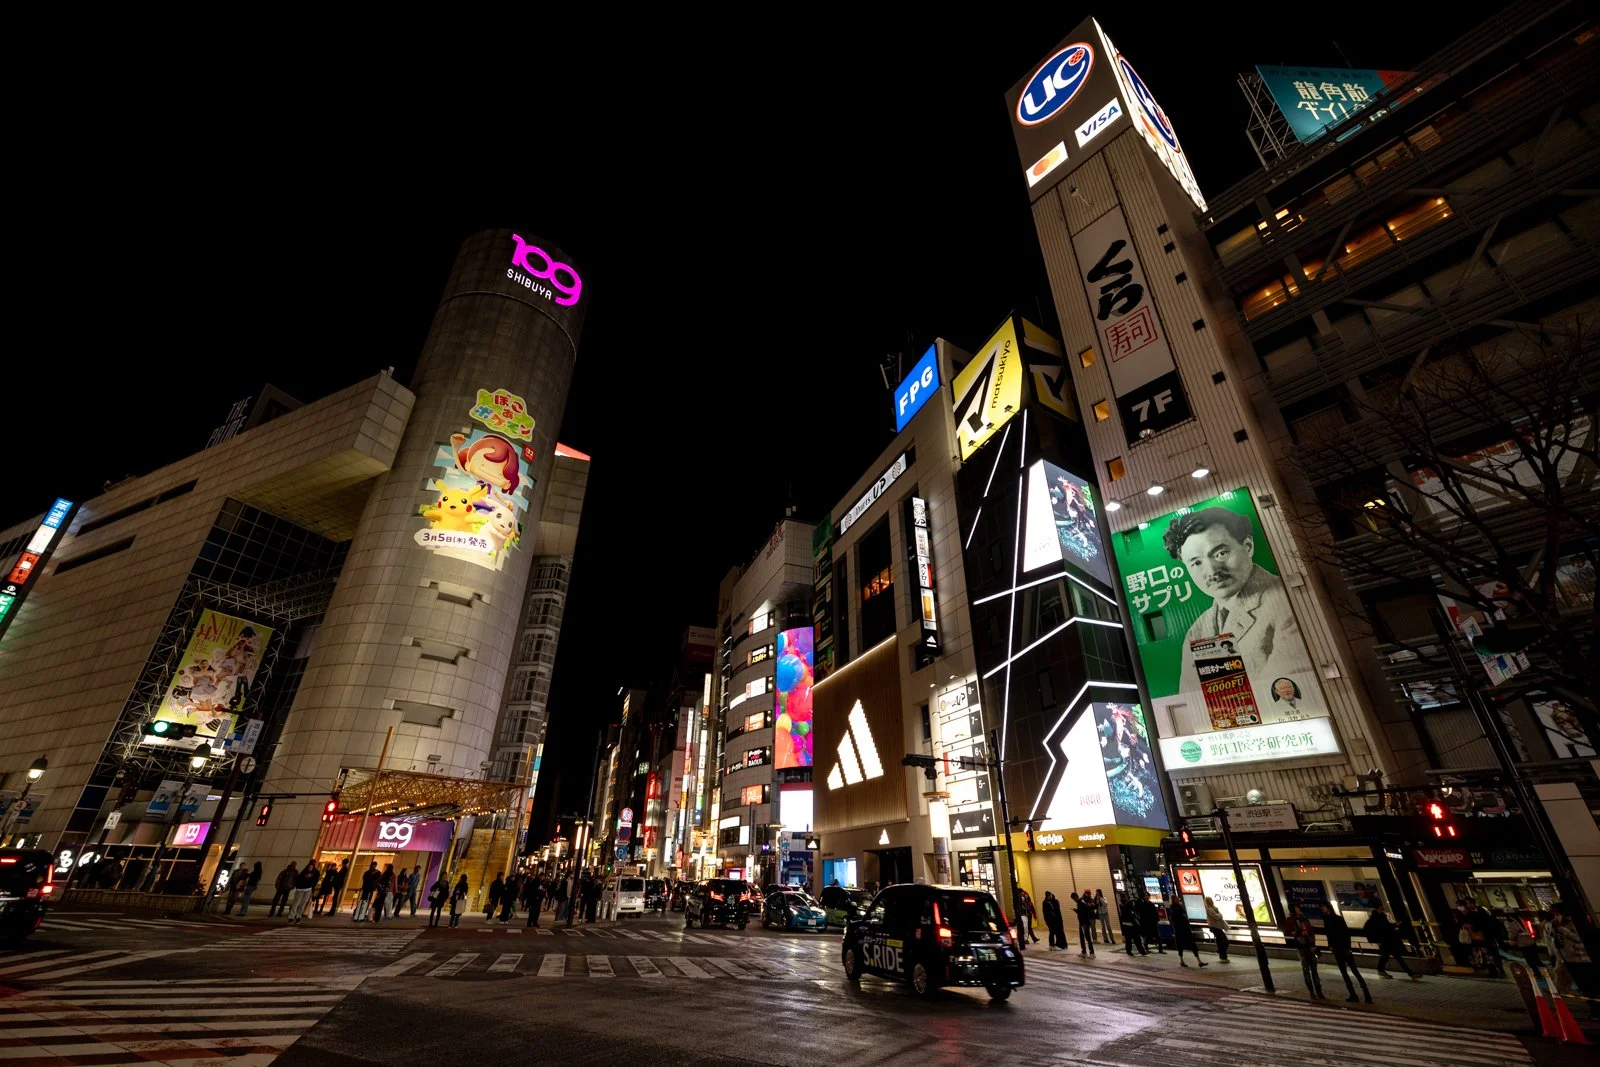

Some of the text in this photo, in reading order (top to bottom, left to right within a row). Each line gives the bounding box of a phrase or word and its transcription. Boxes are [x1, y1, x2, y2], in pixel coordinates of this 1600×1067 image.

[1292, 80, 1371, 103] 龍角散
[1080, 106, 1119, 138] VISA
[506, 268, 553, 301] SHIBUYA
[511, 233, 582, 307] 109
[1086, 239, 1144, 321] くら
[991, 339, 1011, 409] matsukiyo
[899, 365, 934, 417] FPG
[1131, 388, 1174, 424] 7F
[474, 405, 532, 436] ポケモン
[855, 478, 887, 518] Darts UP
[422, 532, 487, 549] 3月5日(木) 発売
[1126, 565, 1184, 593] 野口の
[1132, 584, 1193, 614] サプリ
[1206, 678, 1245, 694] 4000FU
[1209, 732, 1314, 757] 野口医学研究所
[378, 821, 414, 849] 109
[862, 942, 905, 974] S.RIDE
